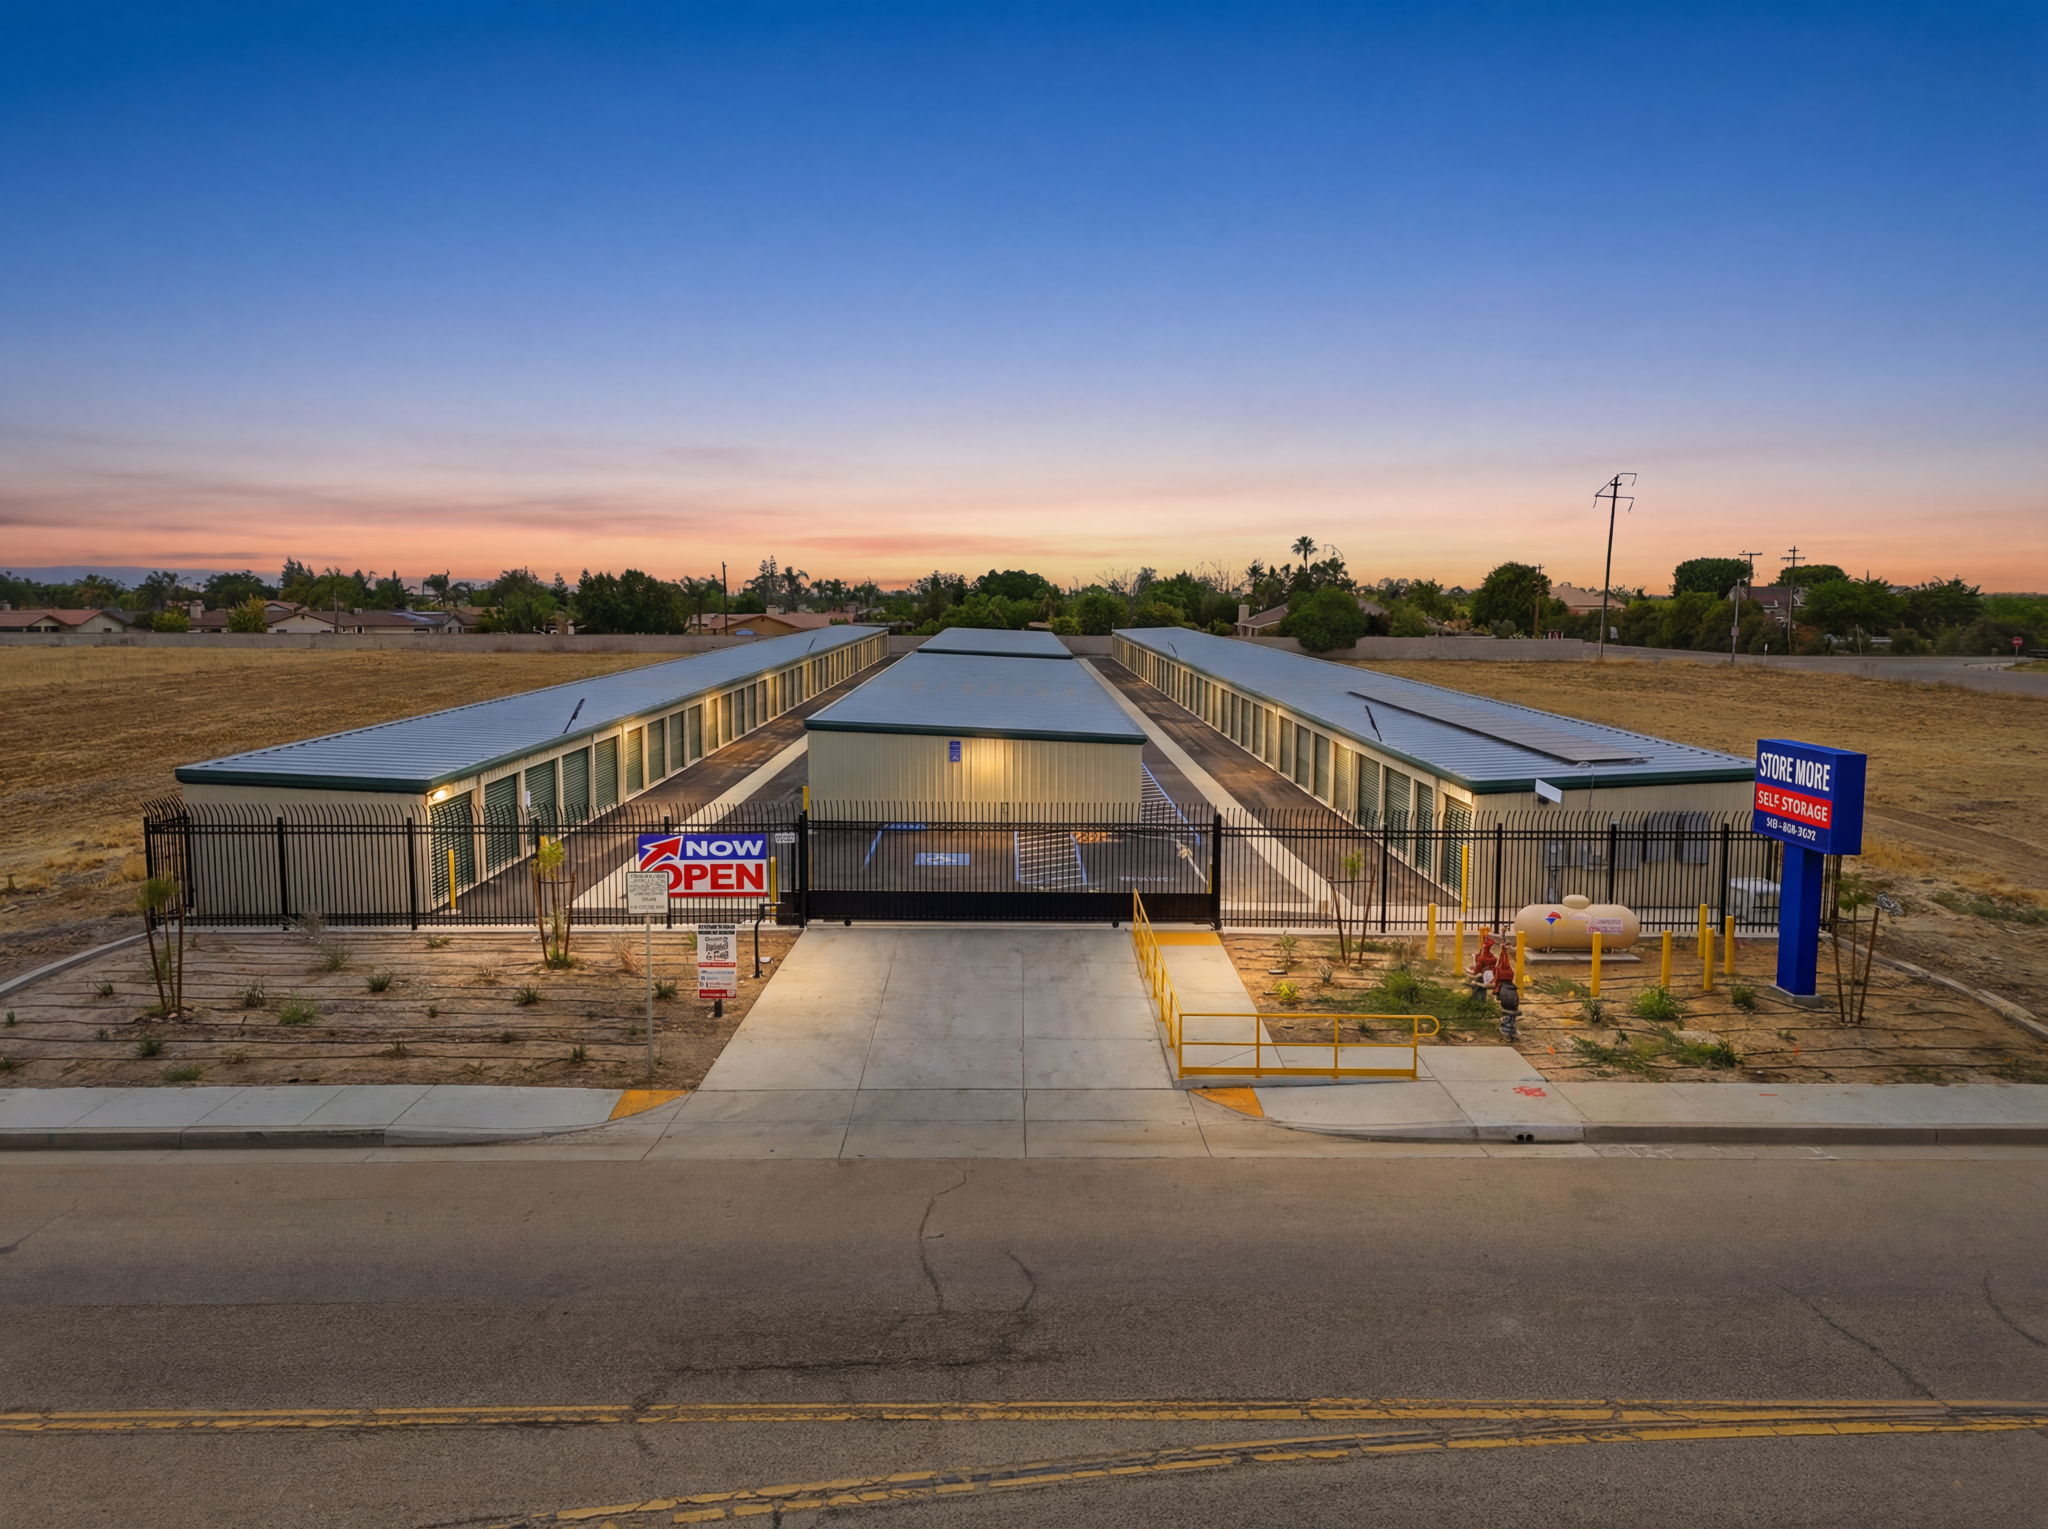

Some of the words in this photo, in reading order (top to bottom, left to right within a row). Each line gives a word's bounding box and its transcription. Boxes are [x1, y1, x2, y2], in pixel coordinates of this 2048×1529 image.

[1760, 752, 1793, 783] STORE
[1795, 759, 1831, 791] MORE
[1758, 790, 1780, 807] SELF
[1781, 796, 1828, 822] STORAGE
[686, 840, 763, 856] NOW
[653, 863, 764, 891] OPEN
